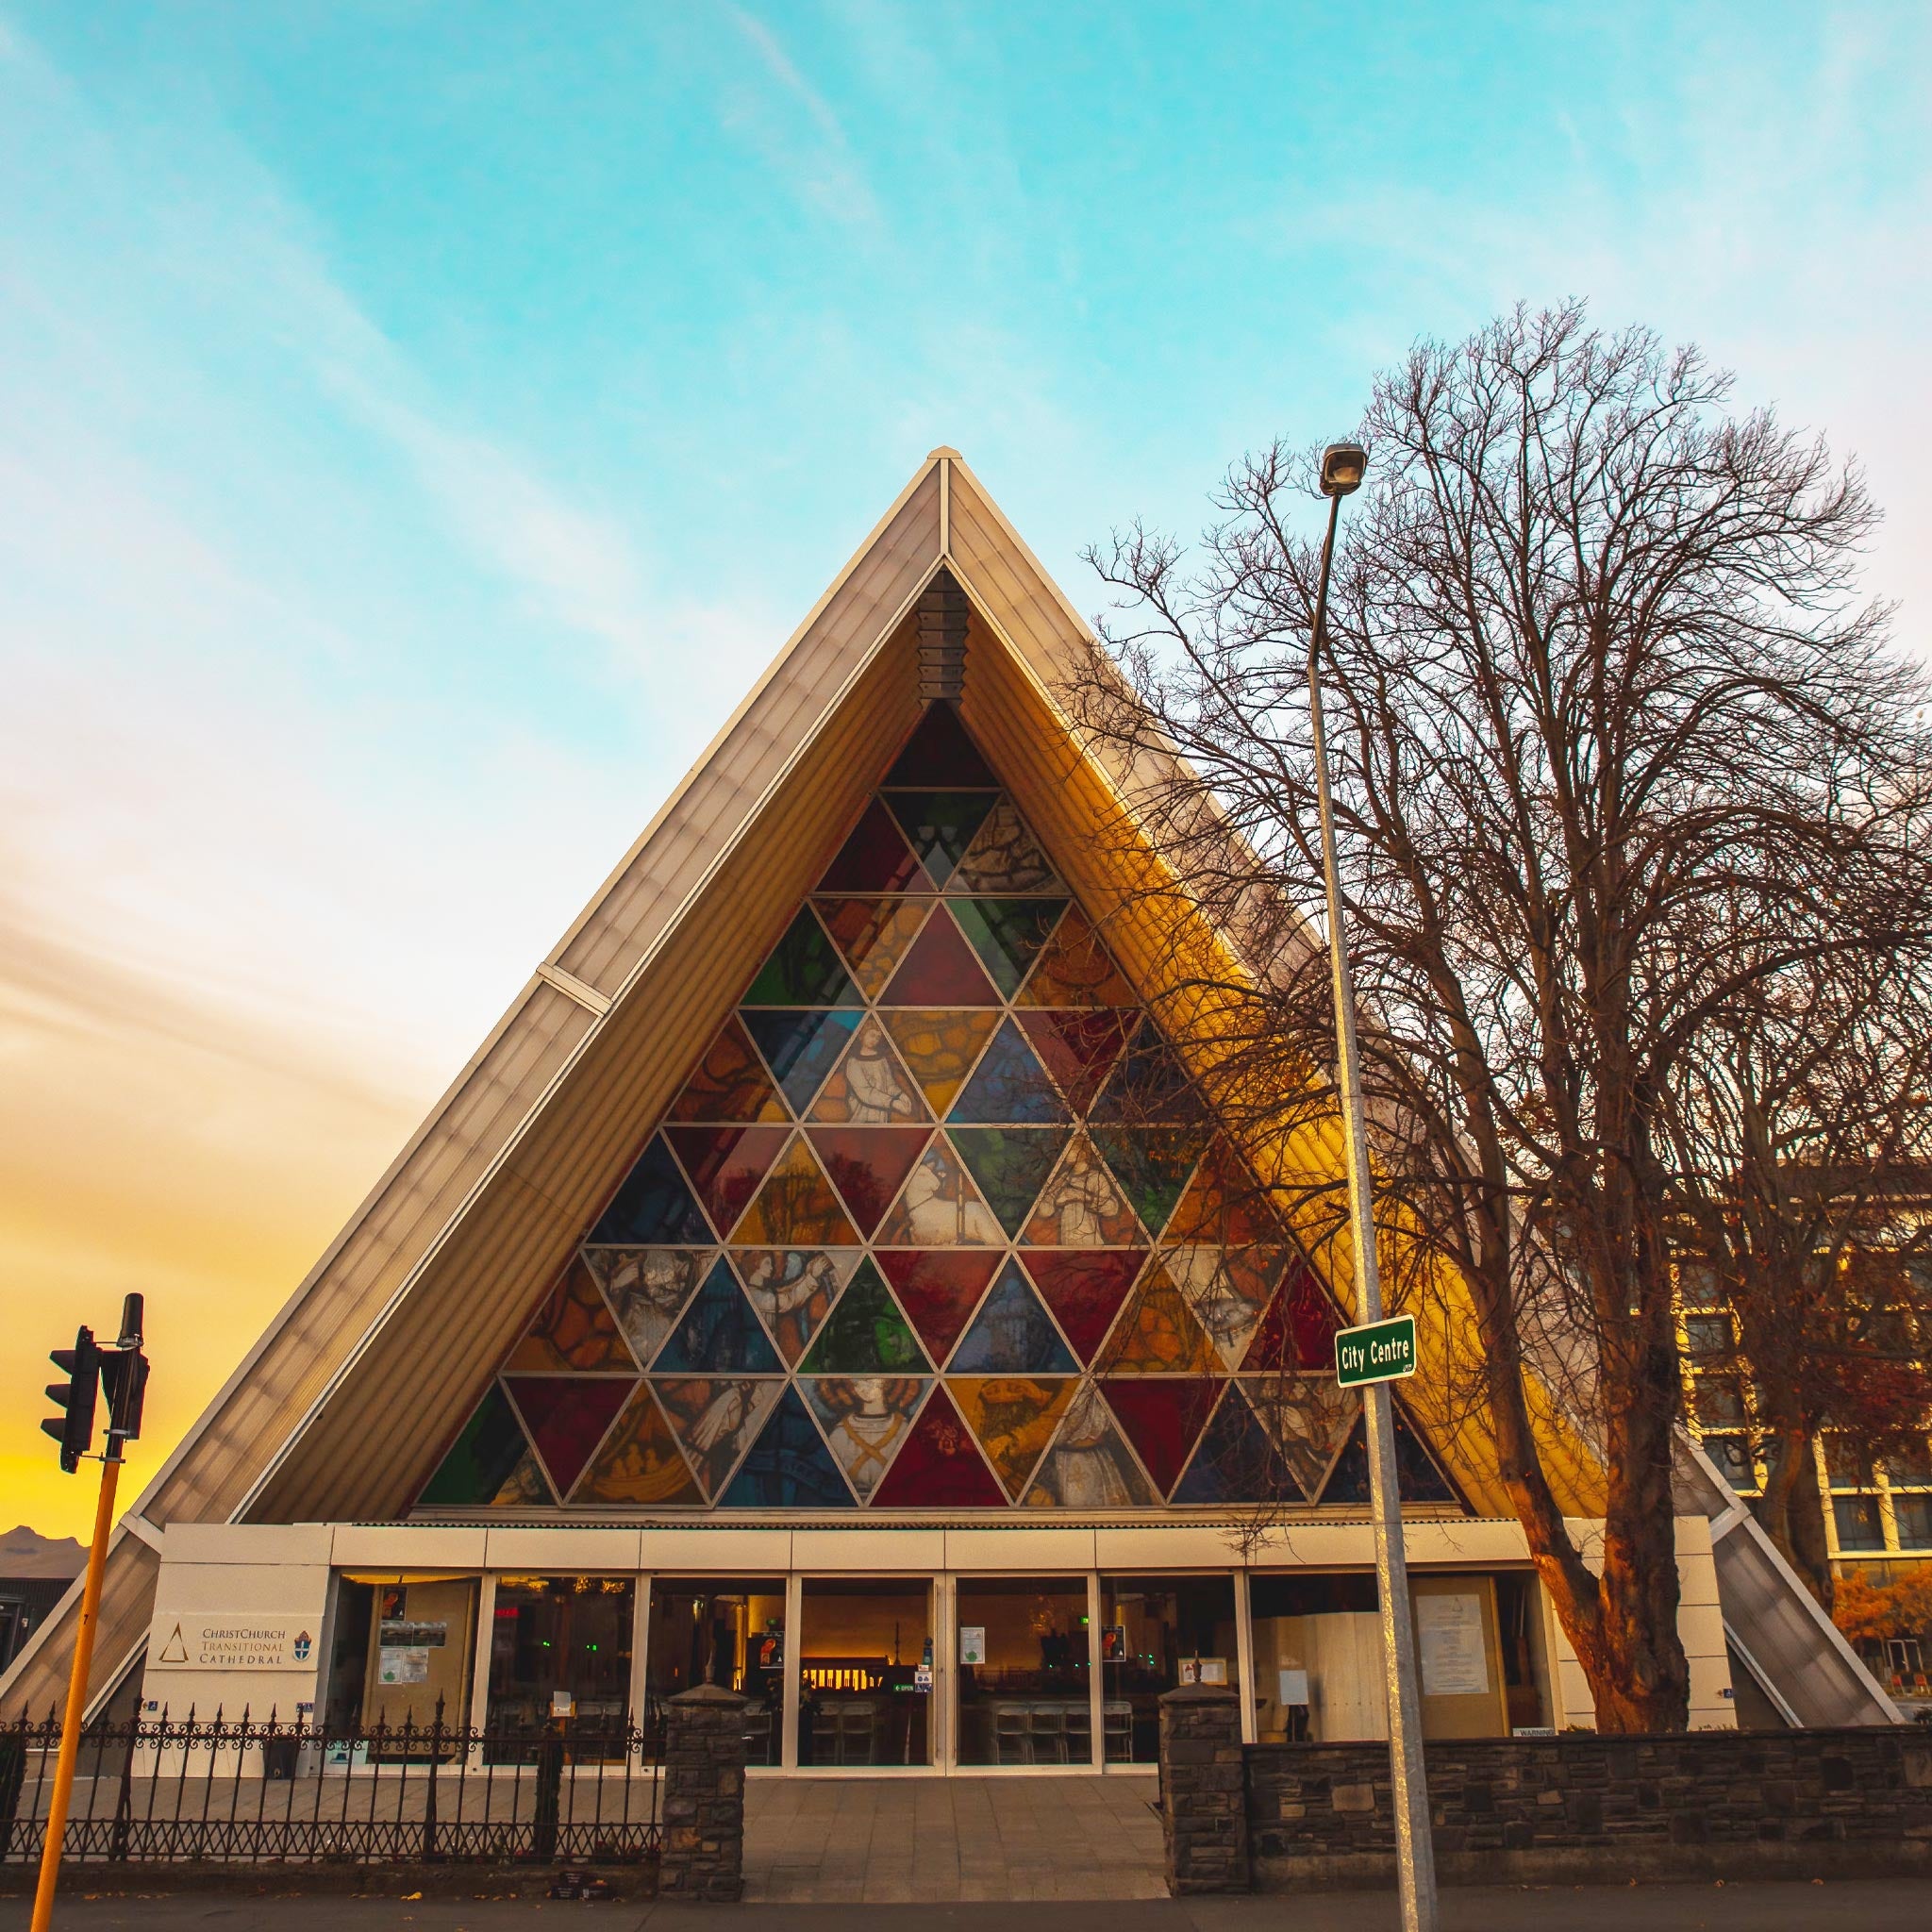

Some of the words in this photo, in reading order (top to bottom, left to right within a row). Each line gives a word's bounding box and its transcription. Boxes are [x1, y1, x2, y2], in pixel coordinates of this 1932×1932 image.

[1341, 1345, 1365, 1373] City
[1371, 1337, 1409, 1364] Centre
[202, 1641, 284, 1653] TRANSITIONAL
[199, 1653, 282, 1664] CATHEDRAL
